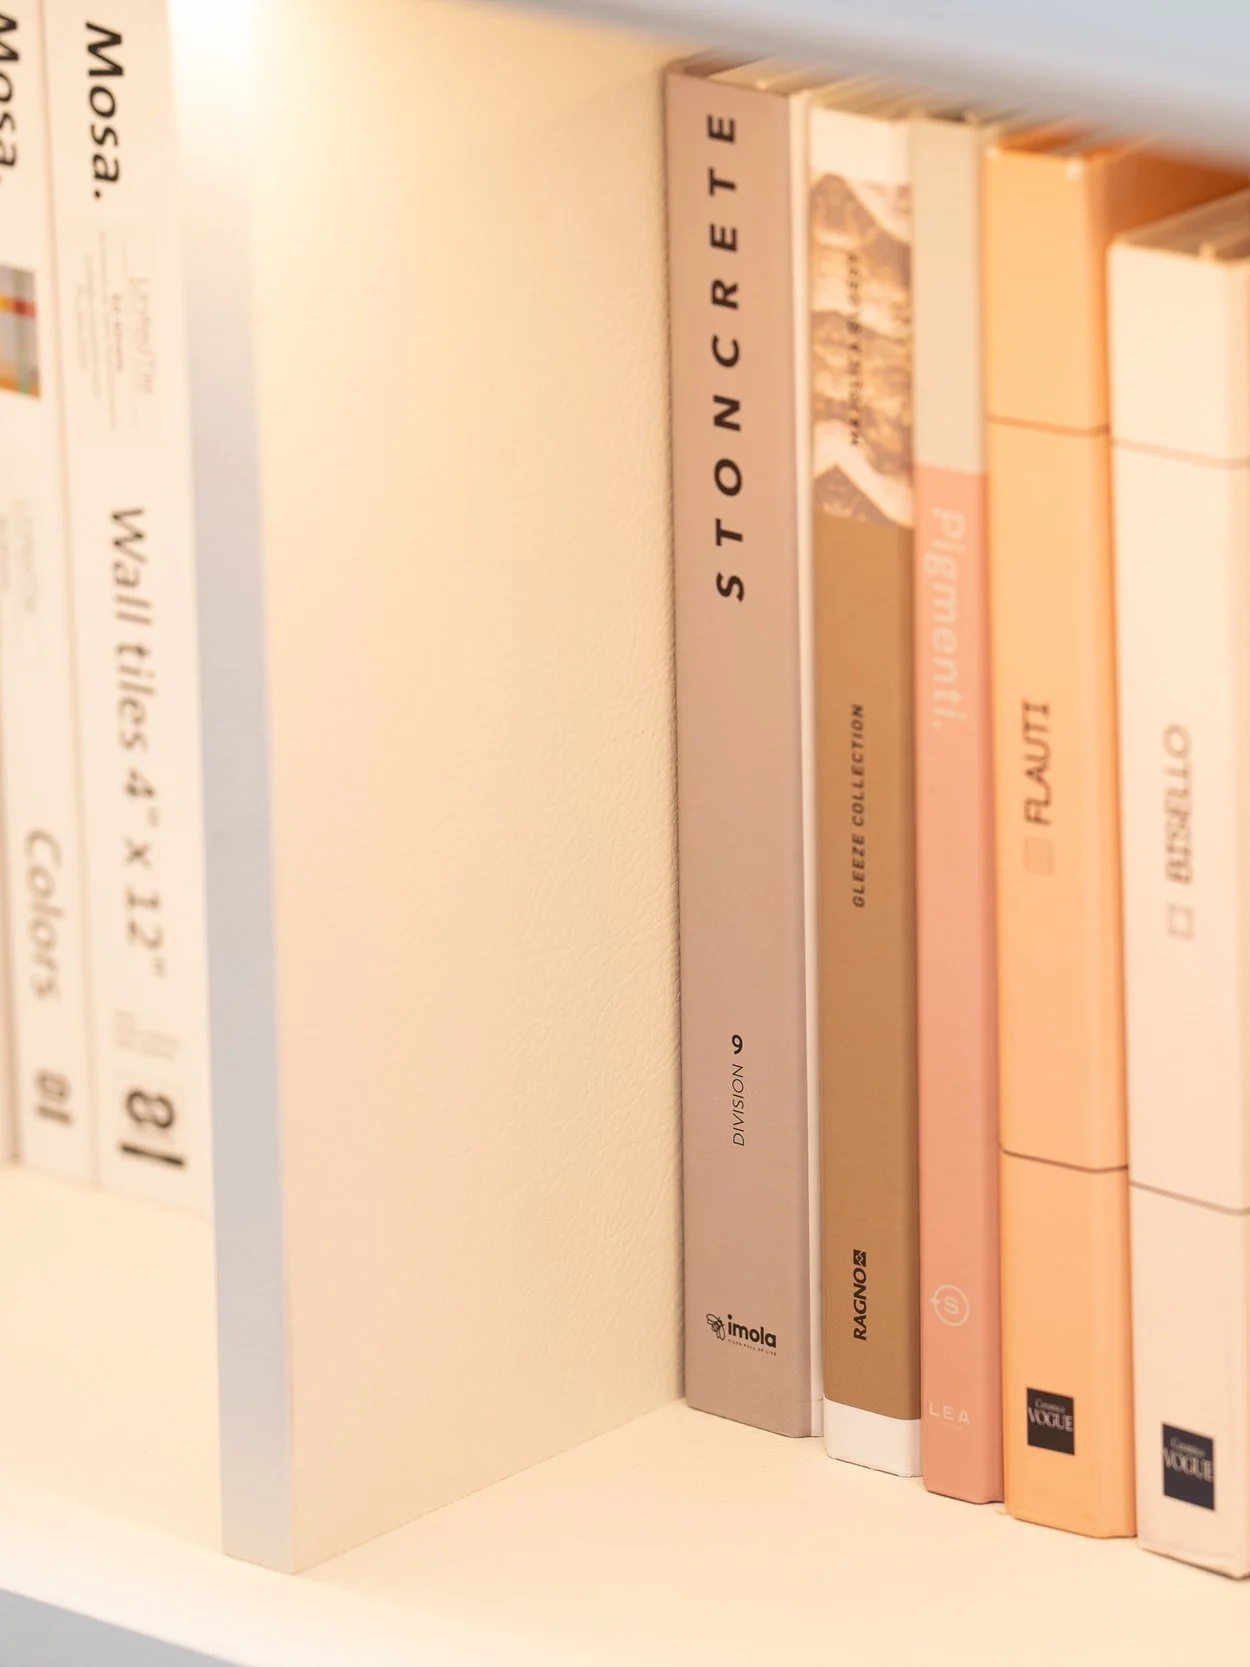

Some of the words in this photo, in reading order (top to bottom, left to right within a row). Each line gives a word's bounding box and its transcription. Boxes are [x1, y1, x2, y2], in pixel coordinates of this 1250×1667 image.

[0, 12, 20, 182] Mosa
[86, 22, 124, 201] Mosa.
[707, 115, 744, 602] STONCRETE
[110, 508, 152, 626] Wall
[116, 643, 156, 752] tiles
[850, 704, 864, 827] COLLECTION
[1021, 697, 1052, 826] FLAUTI
[1162, 724, 1194, 885] BISELLO
[123, 837, 151, 869] x
[852, 832, 865, 908] GLEEZE
[24, 828, 65, 999] Colors
[731, 1034, 744, 1055] 9
[733, 1064, 745, 1147] DIVISION
[727, 1313, 776, 1349] imola
[853, 1266, 867, 1341] RAGNO
[929, 1402, 971, 1425] LEA
[1028, 1406, 1073, 1433] VOGUE
[1163, 1447, 1213, 1482] VOGUE
